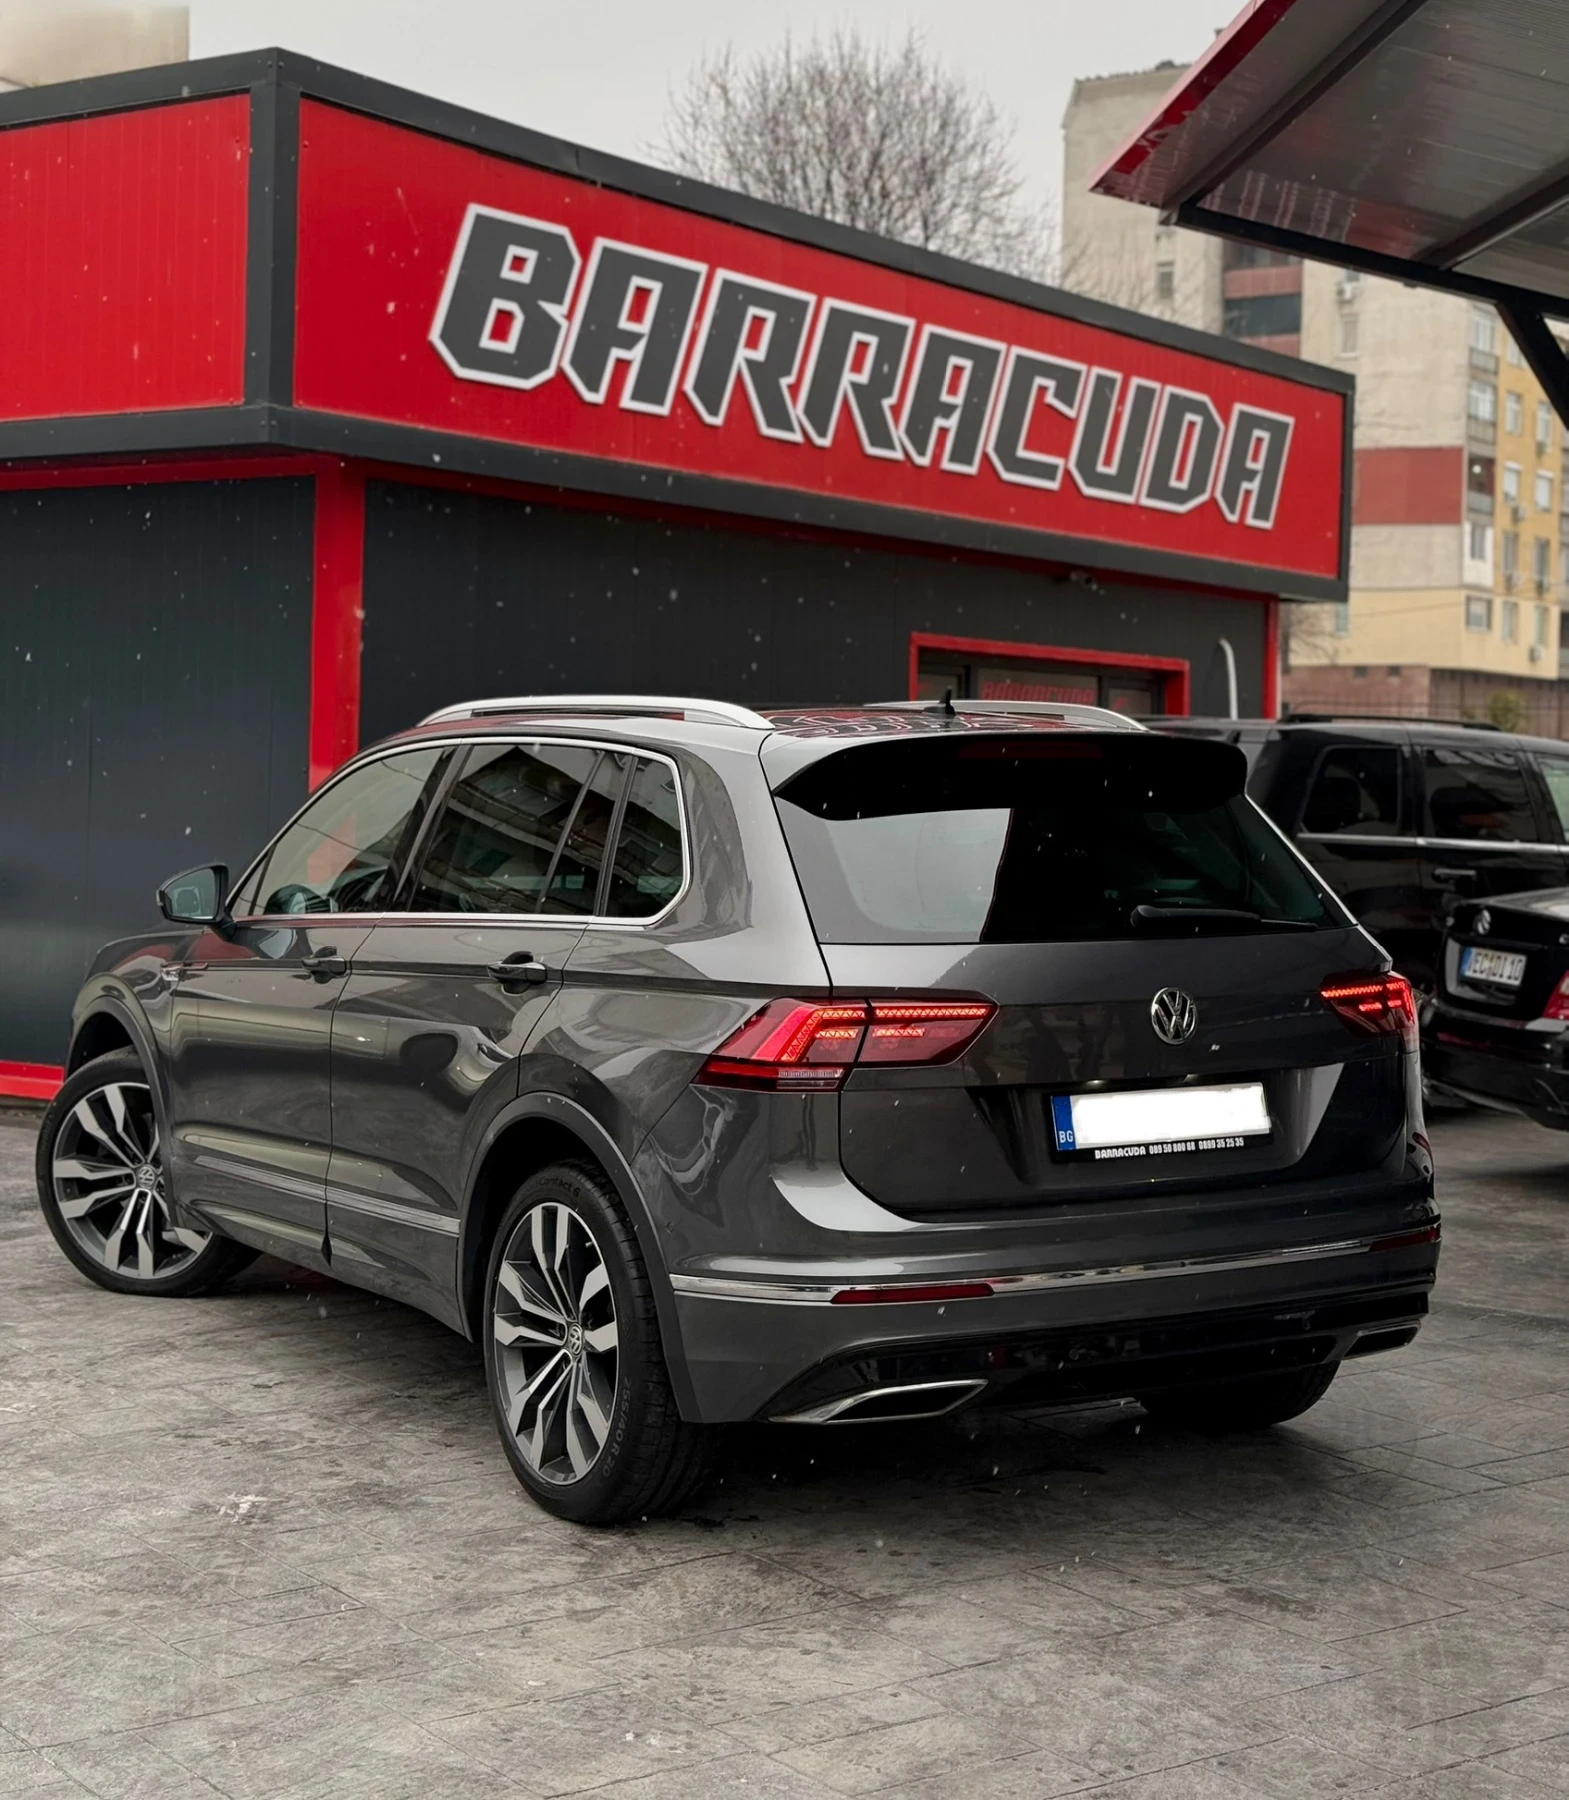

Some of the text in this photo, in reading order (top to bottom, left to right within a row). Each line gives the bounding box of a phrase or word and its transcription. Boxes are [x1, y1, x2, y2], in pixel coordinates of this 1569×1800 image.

[429, 203, 1295, 530] BARRACUDA
[1059, 1130, 1073, 1143] BG
[1095, 1145, 1146, 1159] BARRACUDA
[539, 1176, 581, 1198] Contact 6
